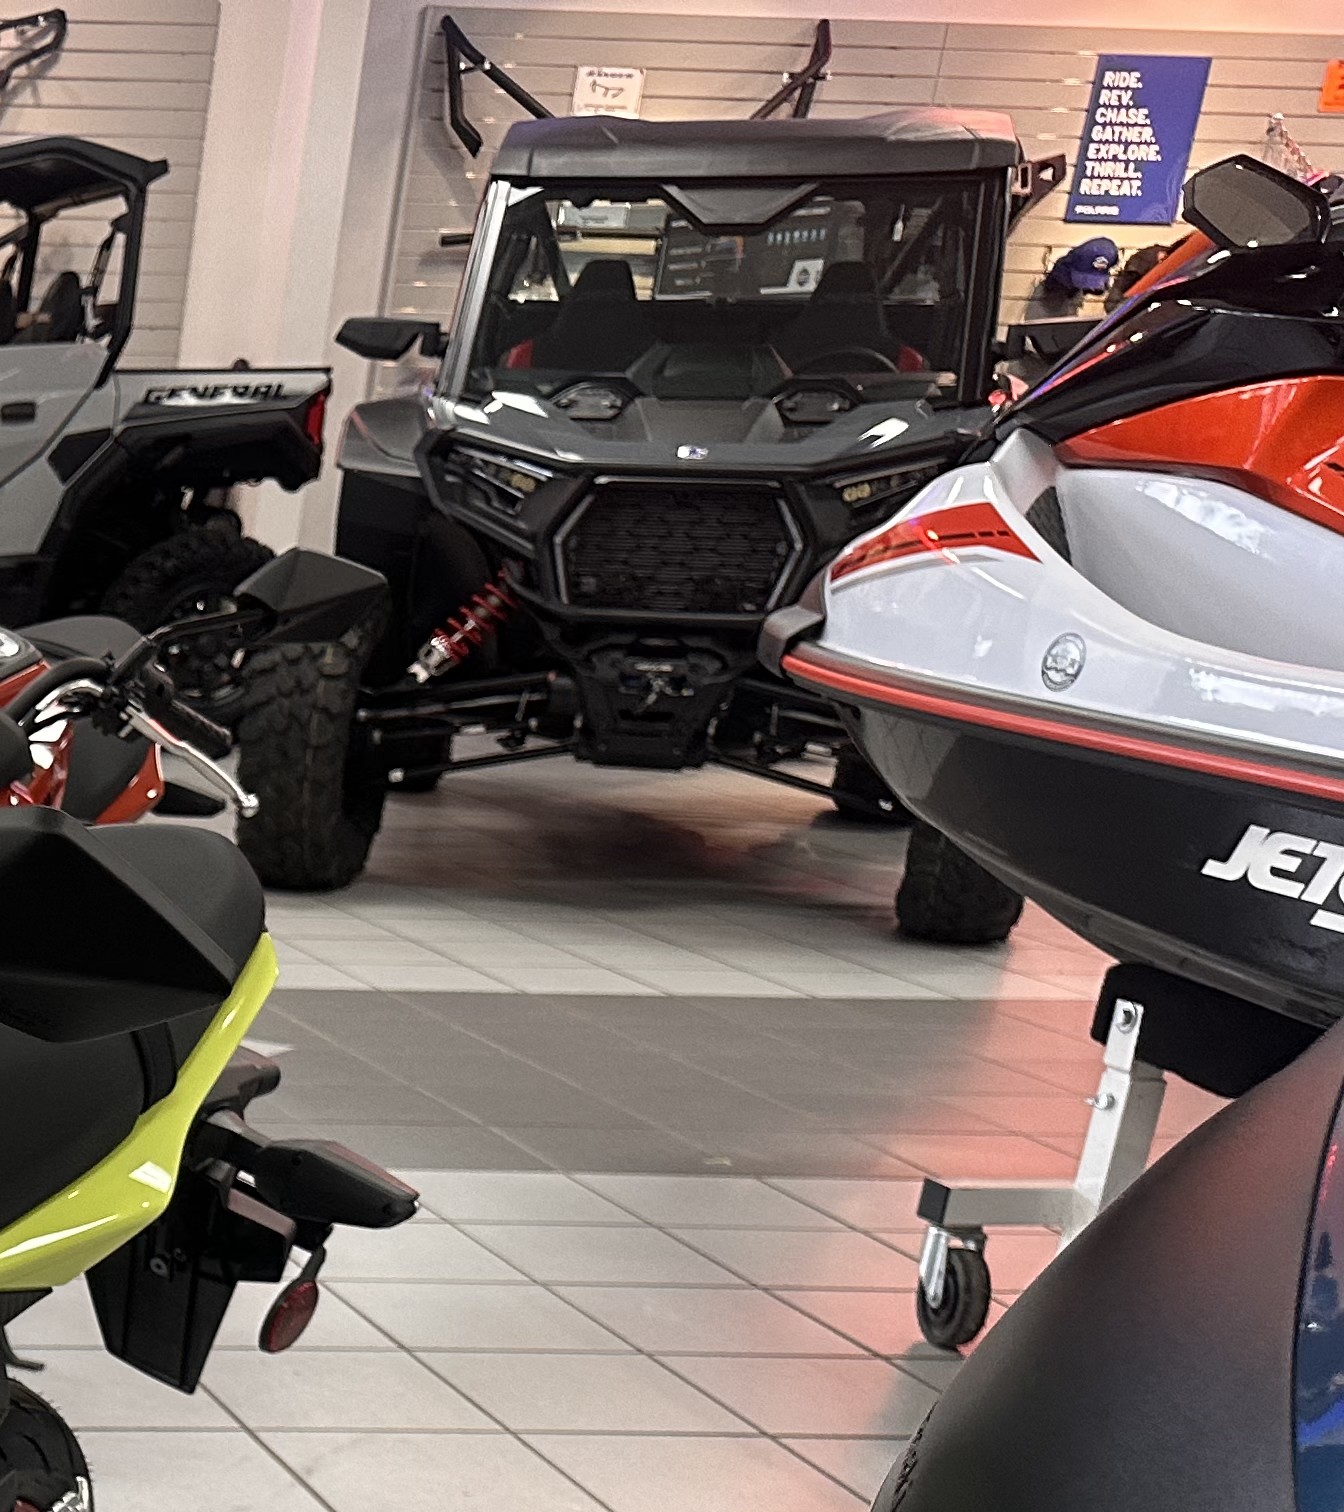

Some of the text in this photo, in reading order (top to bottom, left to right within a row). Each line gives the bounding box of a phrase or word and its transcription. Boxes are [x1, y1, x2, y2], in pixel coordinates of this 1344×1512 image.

[1102, 70, 1143, 89] RIDE.
[1098, 89, 1134, 106] REV.
[1094, 107, 1151, 125] CHASE.
[1090, 125, 1156, 143] GATHER.
[1087, 143, 1162, 162] EXPLORE.
[1085, 160, 1143, 179] THRILL.
[1079, 178, 1143, 197] REPEAT.
